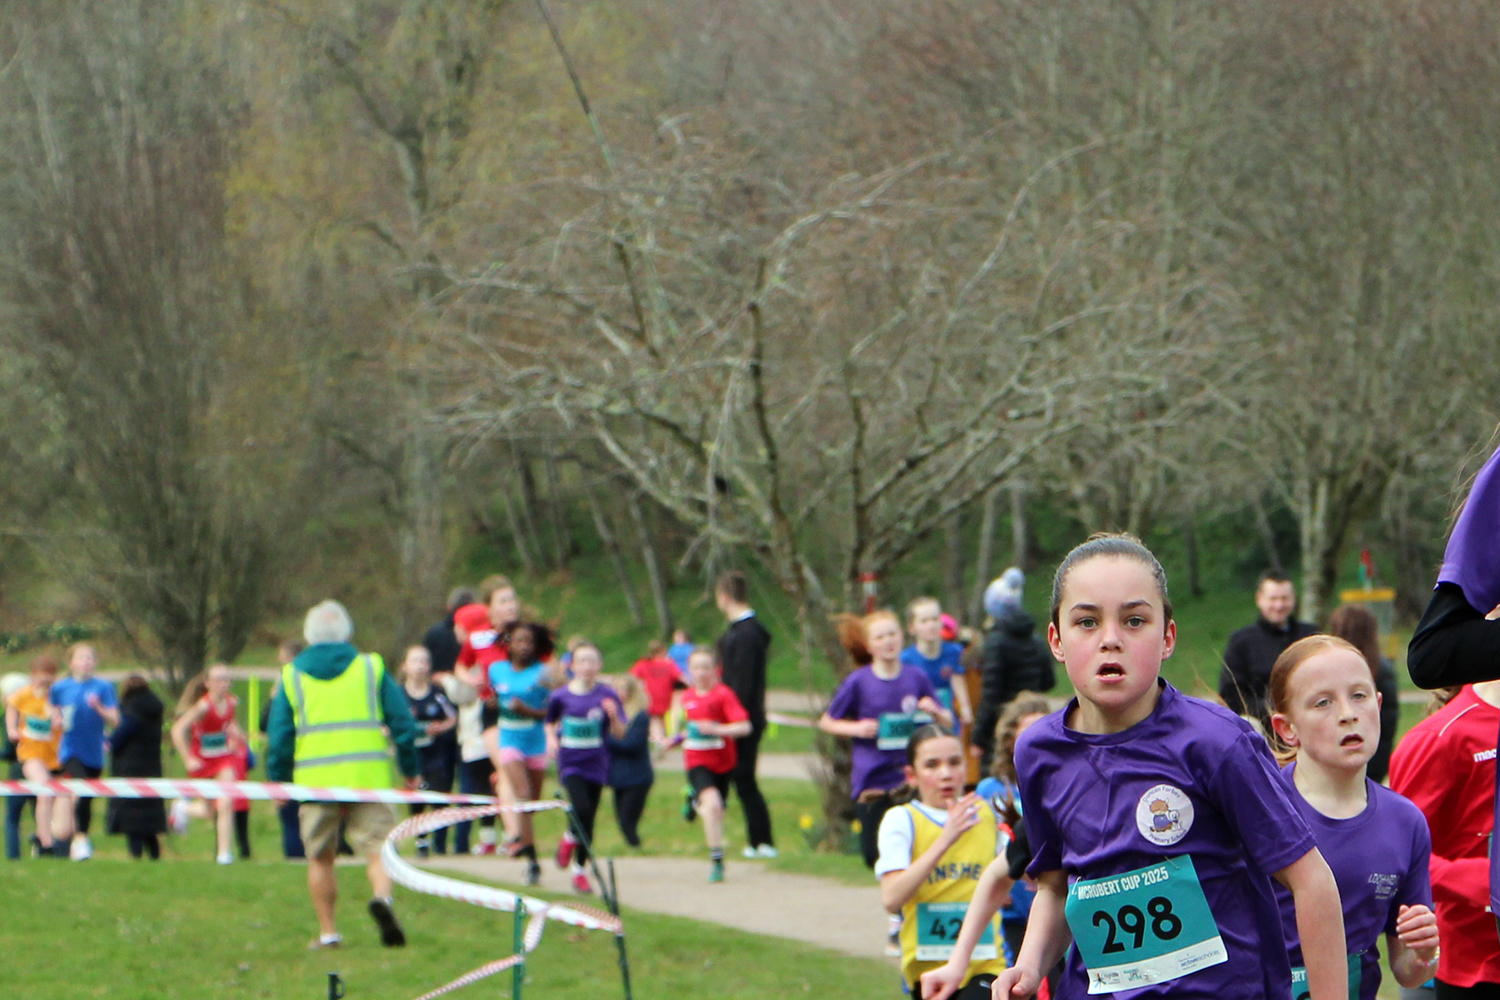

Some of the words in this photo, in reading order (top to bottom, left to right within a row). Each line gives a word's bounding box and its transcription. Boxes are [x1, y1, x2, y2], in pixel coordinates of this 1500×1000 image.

[1077, 879, 1121, 901] MCROBERT
[1120, 874, 1142, 892] CUP
[1141, 866, 1170, 887] 2025
[929, 917, 964, 940] 42
[1092, 896, 1183, 955] 298
